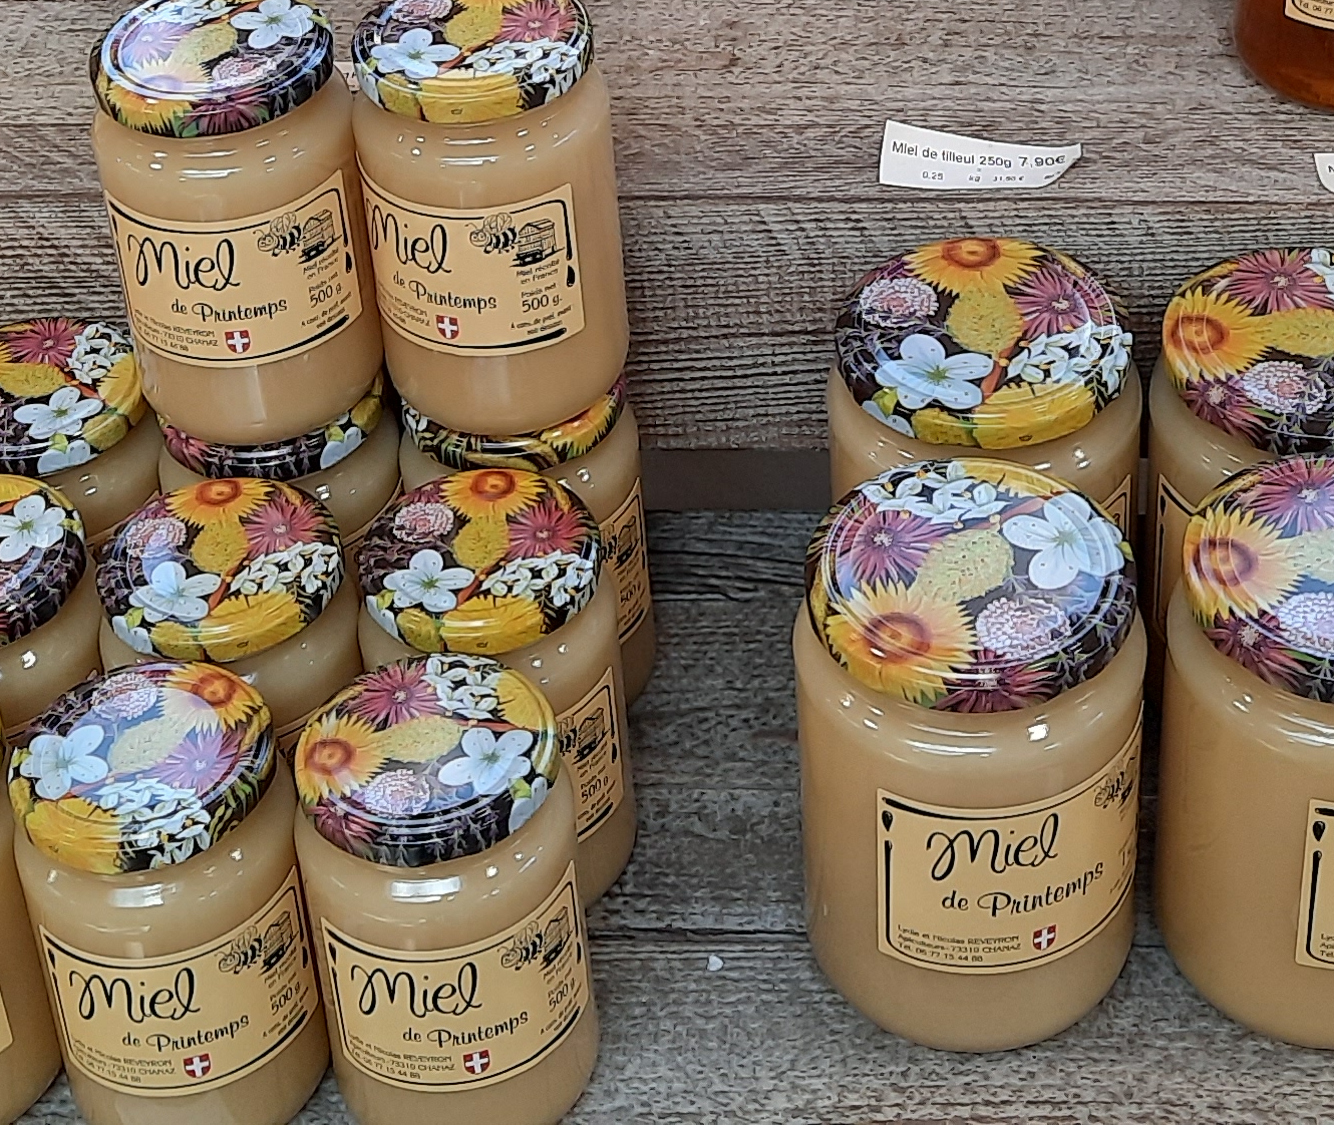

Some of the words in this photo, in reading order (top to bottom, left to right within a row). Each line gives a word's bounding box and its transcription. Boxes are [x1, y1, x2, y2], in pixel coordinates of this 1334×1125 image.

[892, 140, 918, 157] Miel
[922, 146, 938, 160] de
[941, 149, 975, 165] tilleul
[979, 155, 1012, 170] 250g
[1018, 154, 1066, 169] 7,90€
[365, 197, 452, 274] Miel
[127, 234, 241, 292] Miel
[170, 298, 188, 315] de
[191, 298, 288, 323] Printemps
[309, 284, 333, 309] 500
[408, 279, 498, 315] Printemps
[521, 294, 548, 314] 500
[925, 812, 1059, 881] Miel
[941, 890, 969, 911] de
[977, 862, 1104, 918] Printemps
[967, 935, 1019, 946] REVEYRON
[68, 966, 201, 1024] Miel
[270, 989, 293, 1016] 500
[350, 961, 483, 1018] Miel
[548, 983, 569, 1014] 500
[121, 1031, 141, 1048] de
[145, 1014, 250, 1053] Printemps
[402, 1027, 422, 1043] de
[427, 1011, 529, 1048] Printemps
